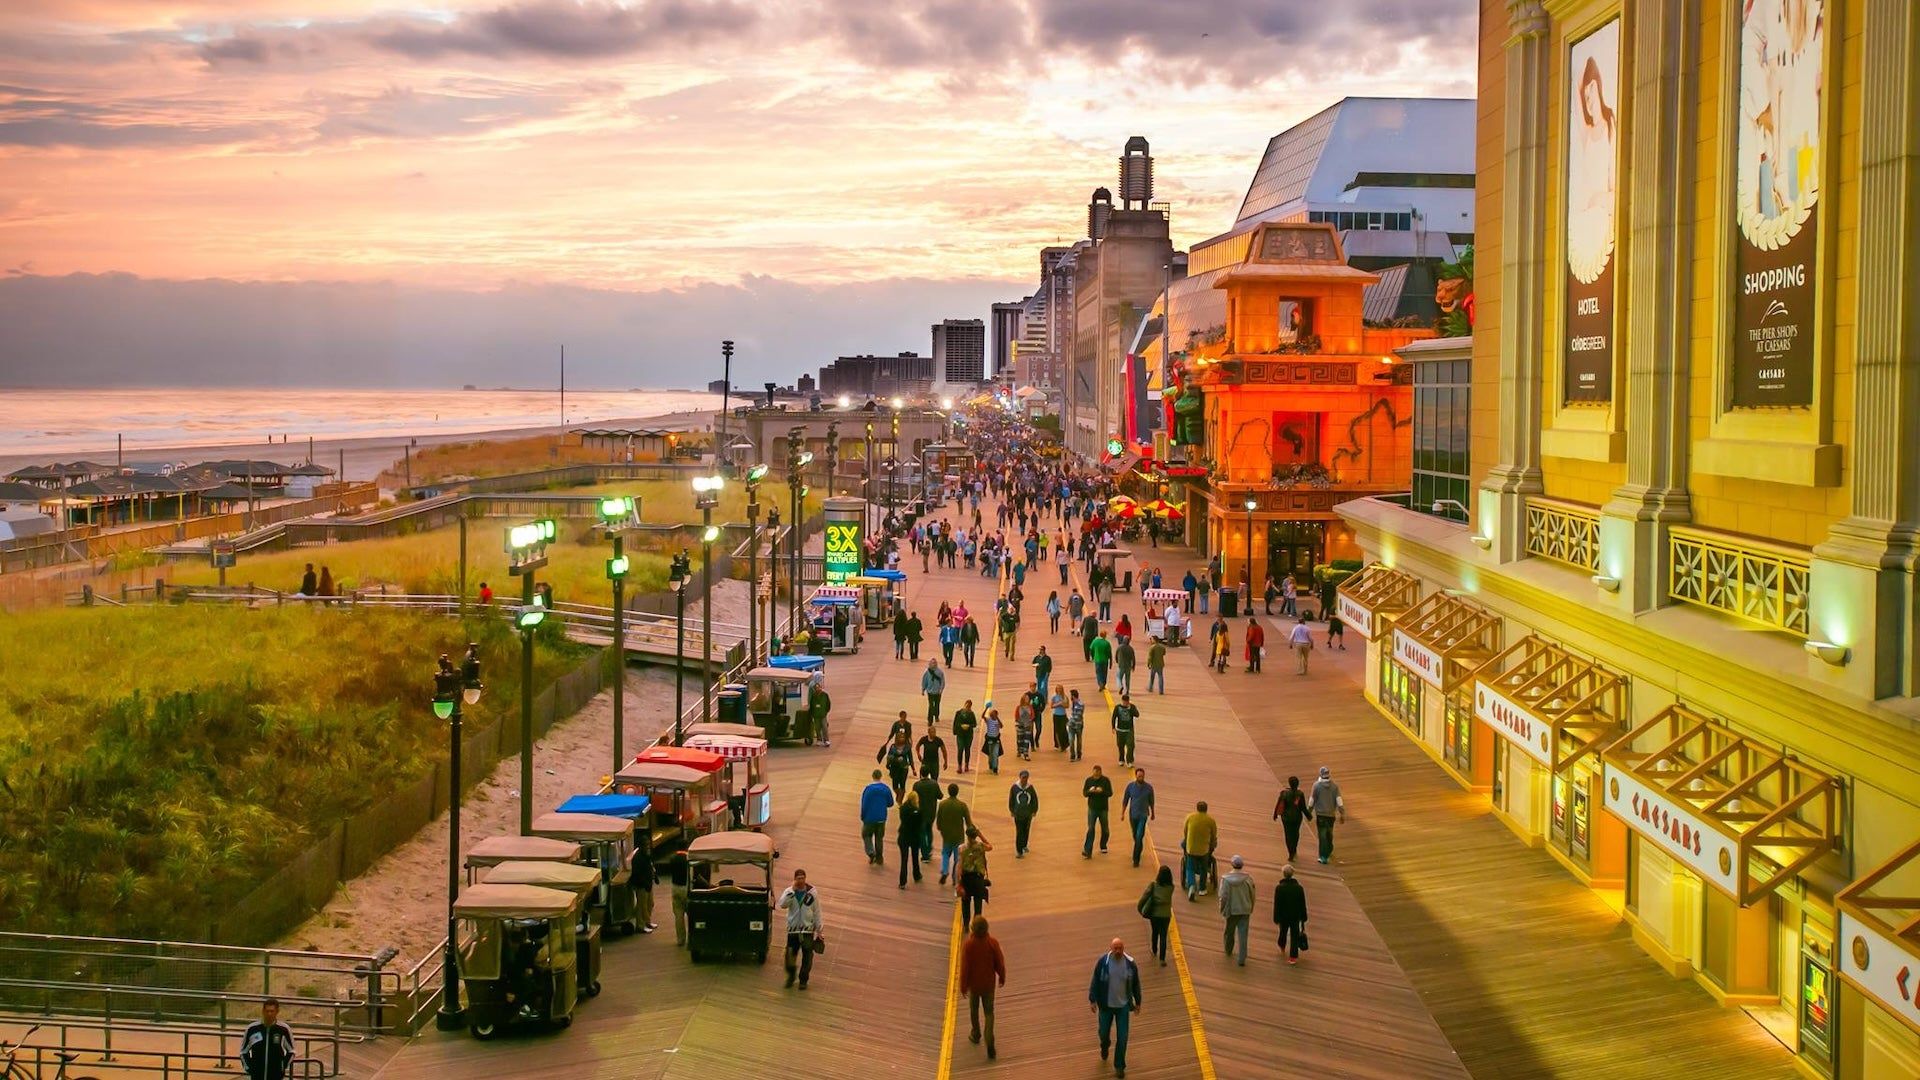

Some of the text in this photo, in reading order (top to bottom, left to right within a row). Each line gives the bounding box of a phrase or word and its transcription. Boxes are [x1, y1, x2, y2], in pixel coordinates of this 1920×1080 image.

[1744, 264, 1805, 295] SHOPPING
[1578, 297, 1600, 316] HOTEL
[1749, 324, 1798, 341] THE PIER SHOPS
[1756, 338, 1791, 353] AT CAESARS
[1758, 368, 1786, 379] CAESARS
[827, 526, 858, 551] 3X
[827, 556, 858, 564] MULTIPLIER
[827, 571, 844, 580] EVERY
[1404, 641, 1431, 672] CAESARS
[1491, 699, 1532, 742] CAESARS
[1632, 792, 1701, 857] CAESARS
